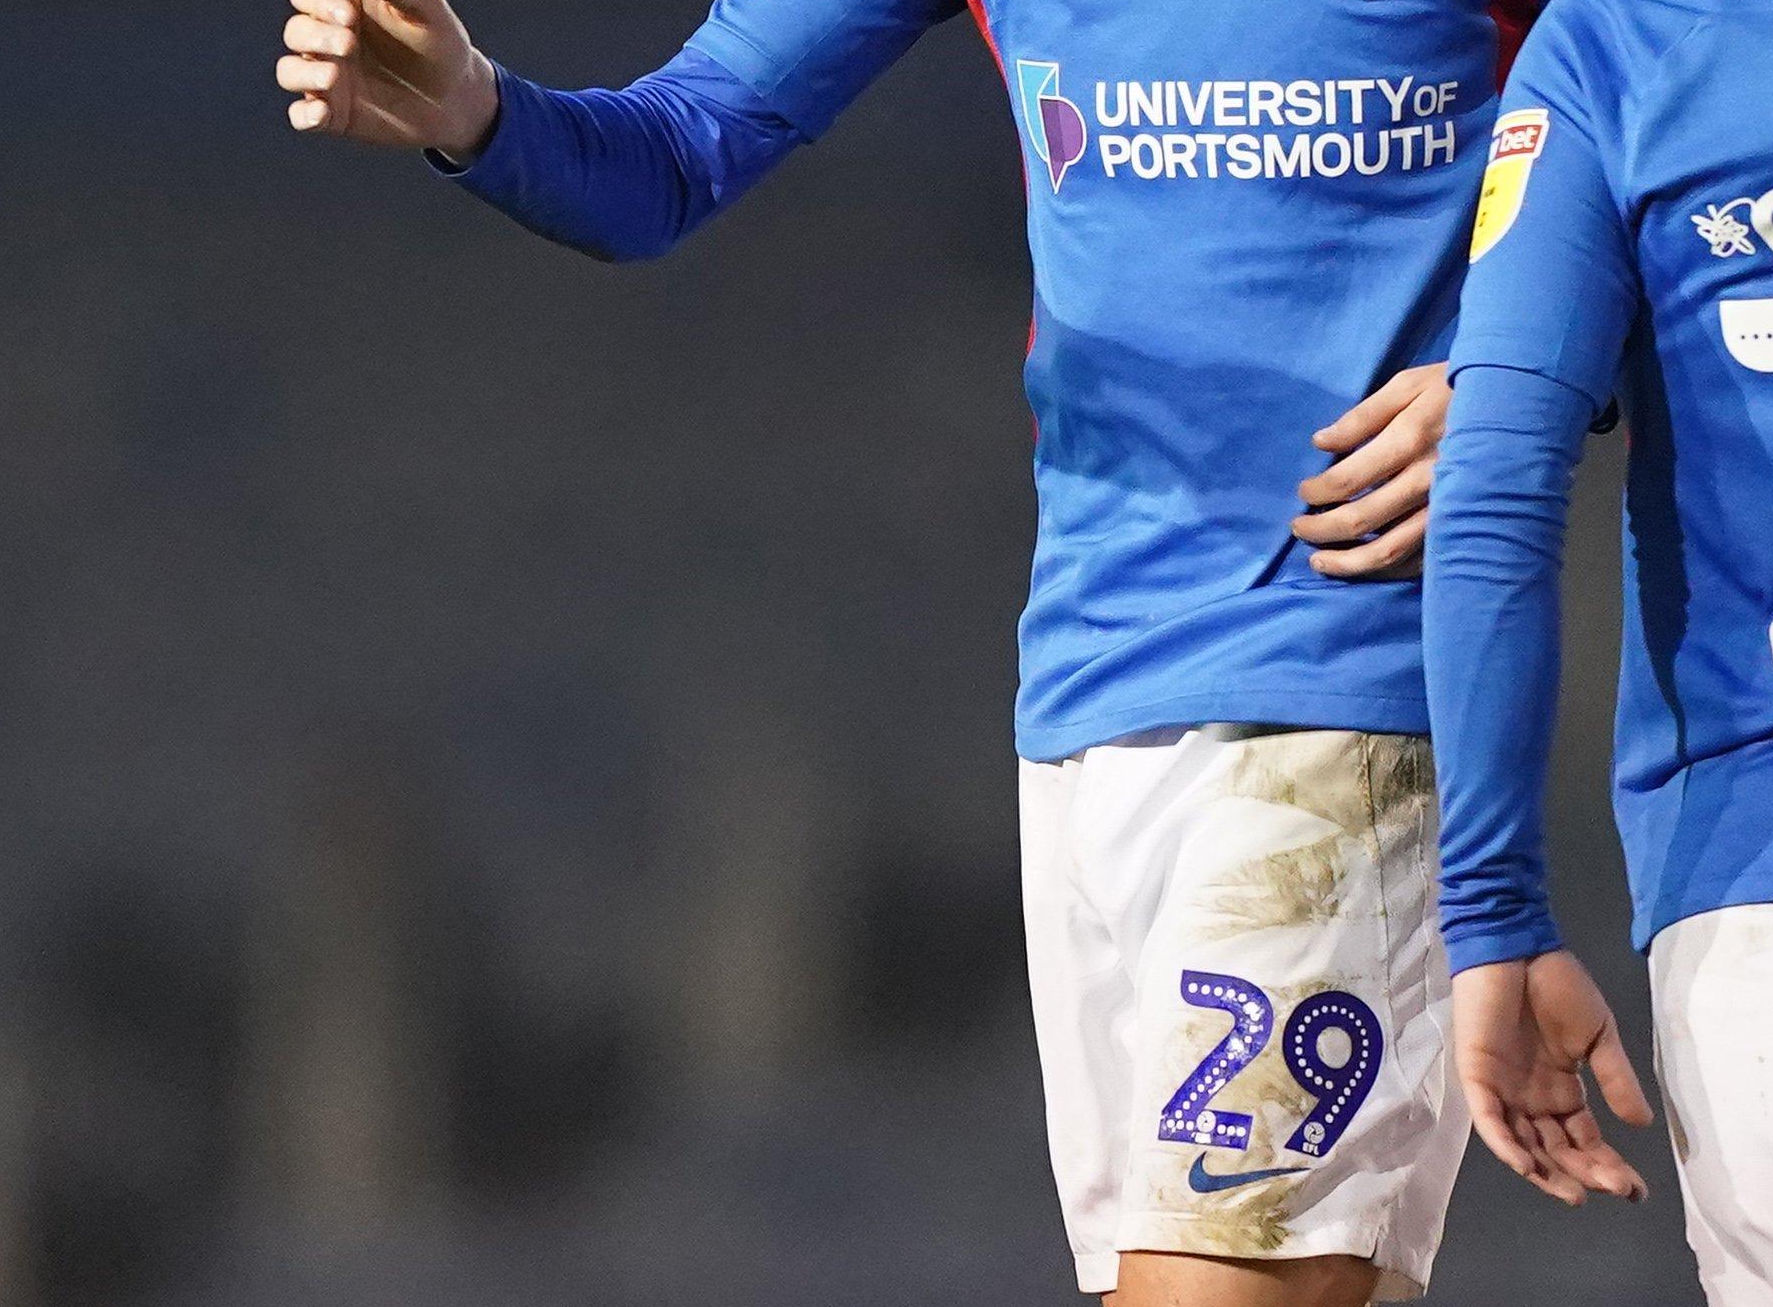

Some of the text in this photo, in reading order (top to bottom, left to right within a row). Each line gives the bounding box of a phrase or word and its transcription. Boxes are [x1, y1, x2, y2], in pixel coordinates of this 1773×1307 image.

[1095, 76, 1458, 127] UNIVERSITY OF
[1097, 120, 1456, 180] PORTSMOUTH
[1499, 126, 1538, 153] bet
[1157, 969, 1385, 1159] 29
